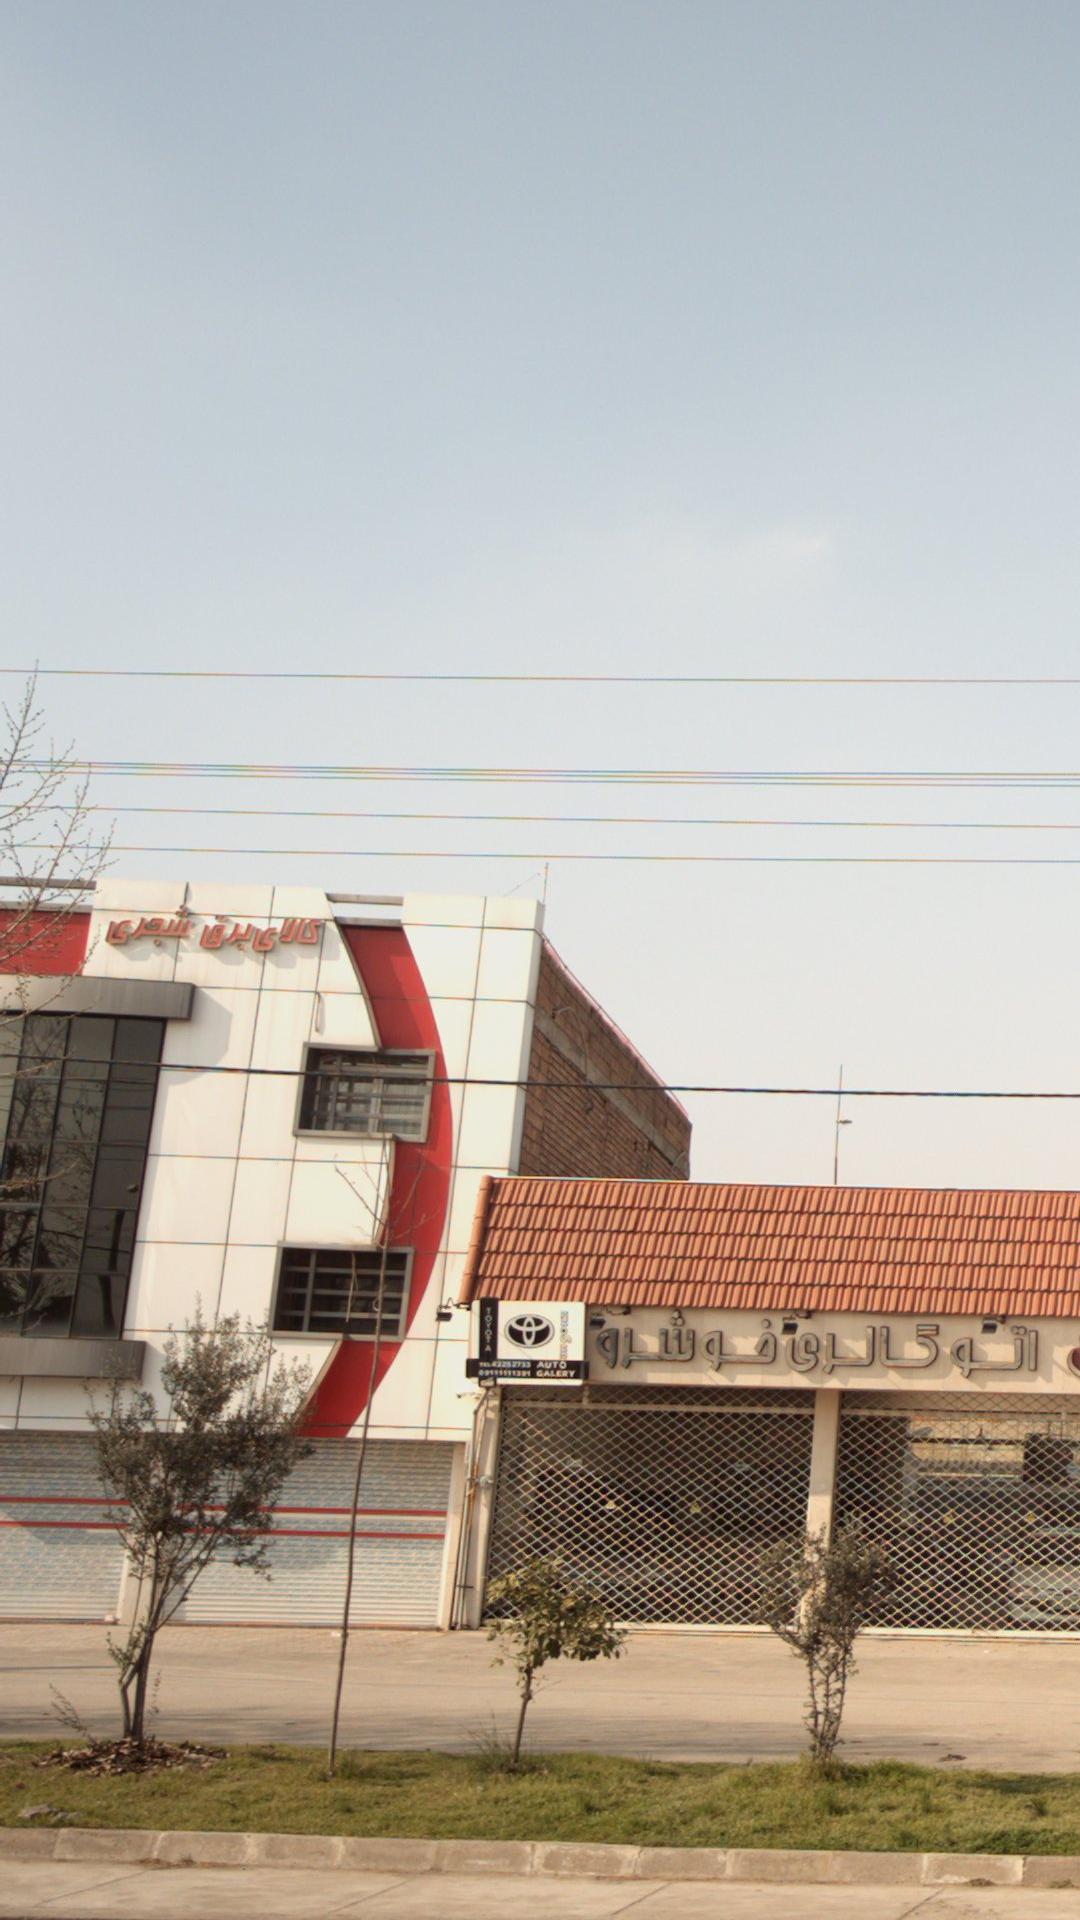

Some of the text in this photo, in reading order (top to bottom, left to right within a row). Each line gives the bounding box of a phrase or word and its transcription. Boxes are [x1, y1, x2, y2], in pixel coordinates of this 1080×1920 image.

[199, 915, 254, 951] برق
[484, 1307, 493, 1352] TOYOTA
[595, 1309, 777, 1371] خوشرو
[784, 1324, 939, 1374] گالری
[950, 1325, 1039, 1378] اتو
[536, 1361, 567, 1369] AUTO
